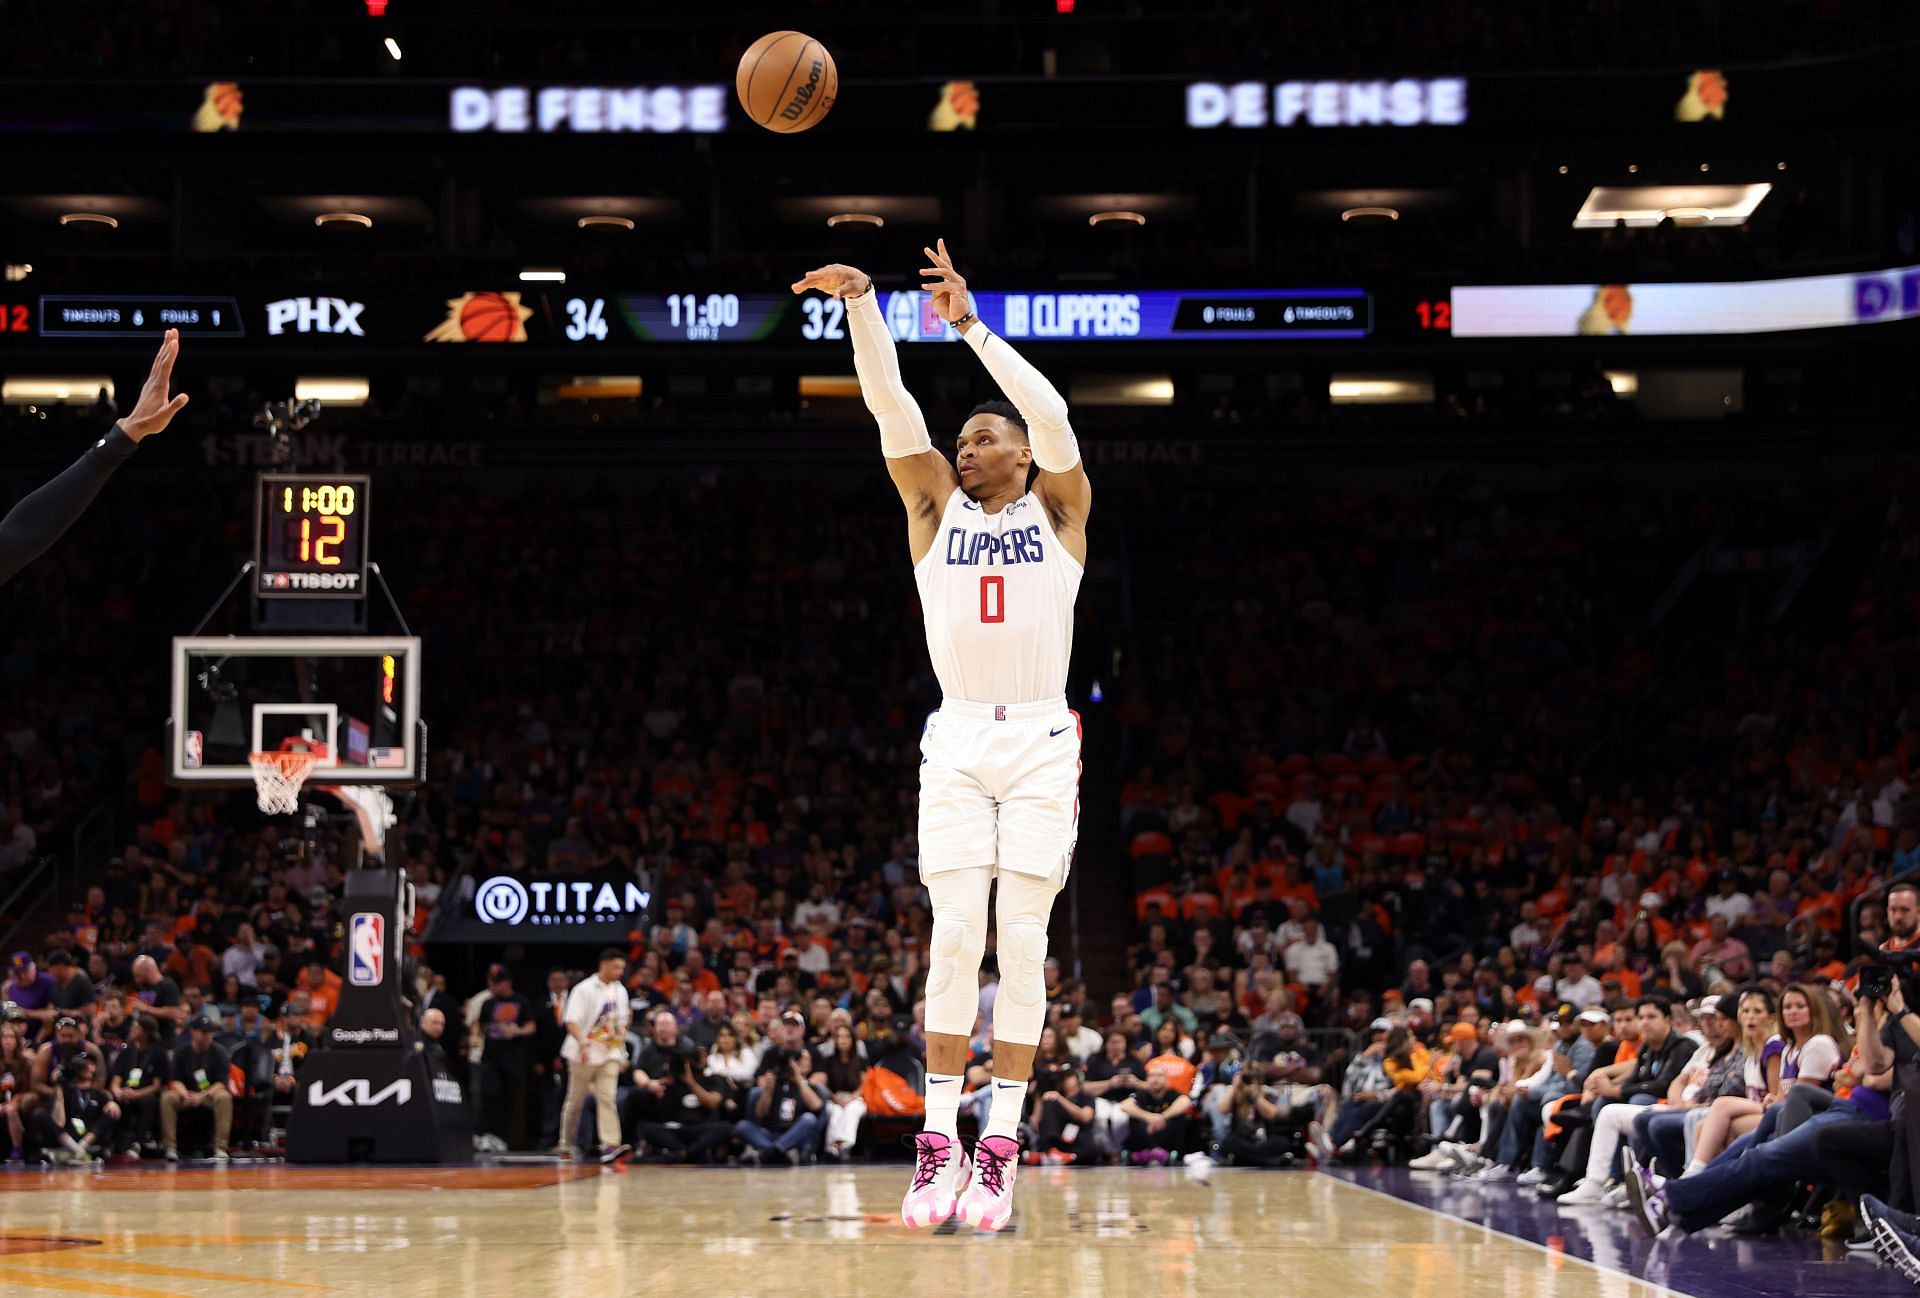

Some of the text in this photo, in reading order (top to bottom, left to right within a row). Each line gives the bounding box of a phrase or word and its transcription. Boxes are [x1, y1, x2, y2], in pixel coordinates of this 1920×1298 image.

[780, 60, 823, 121] Wilson
[62, 308, 144, 326] TIMEOUTS 6
[160, 309, 221, 326] FOULS 1
[266, 297, 365, 336] PHX
[565, 298, 609, 341] 34
[666, 294, 740, 327] 11:00
[802, 298, 845, 340] 32
[1032, 294, 1141, 337] CLIPPERS
[1216, 307, 1256, 322] FOULS
[1284, 306, 1355, 323] 6 TIMEOUTS
[1416, 301, 1451, 329] 12
[357, 440, 484, 467] TERRACE
[284, 485, 355, 516] 11:00
[300, 515, 345, 566] 12
[946, 524, 1044, 566] CLIPPERS
[289, 572, 360, 589] TISSOT
[980, 575, 1005, 623] 0
[530, 882, 651, 913] TITAN
[332, 1028, 373, 1044] Google
[308, 1078, 412, 1106] KIA
